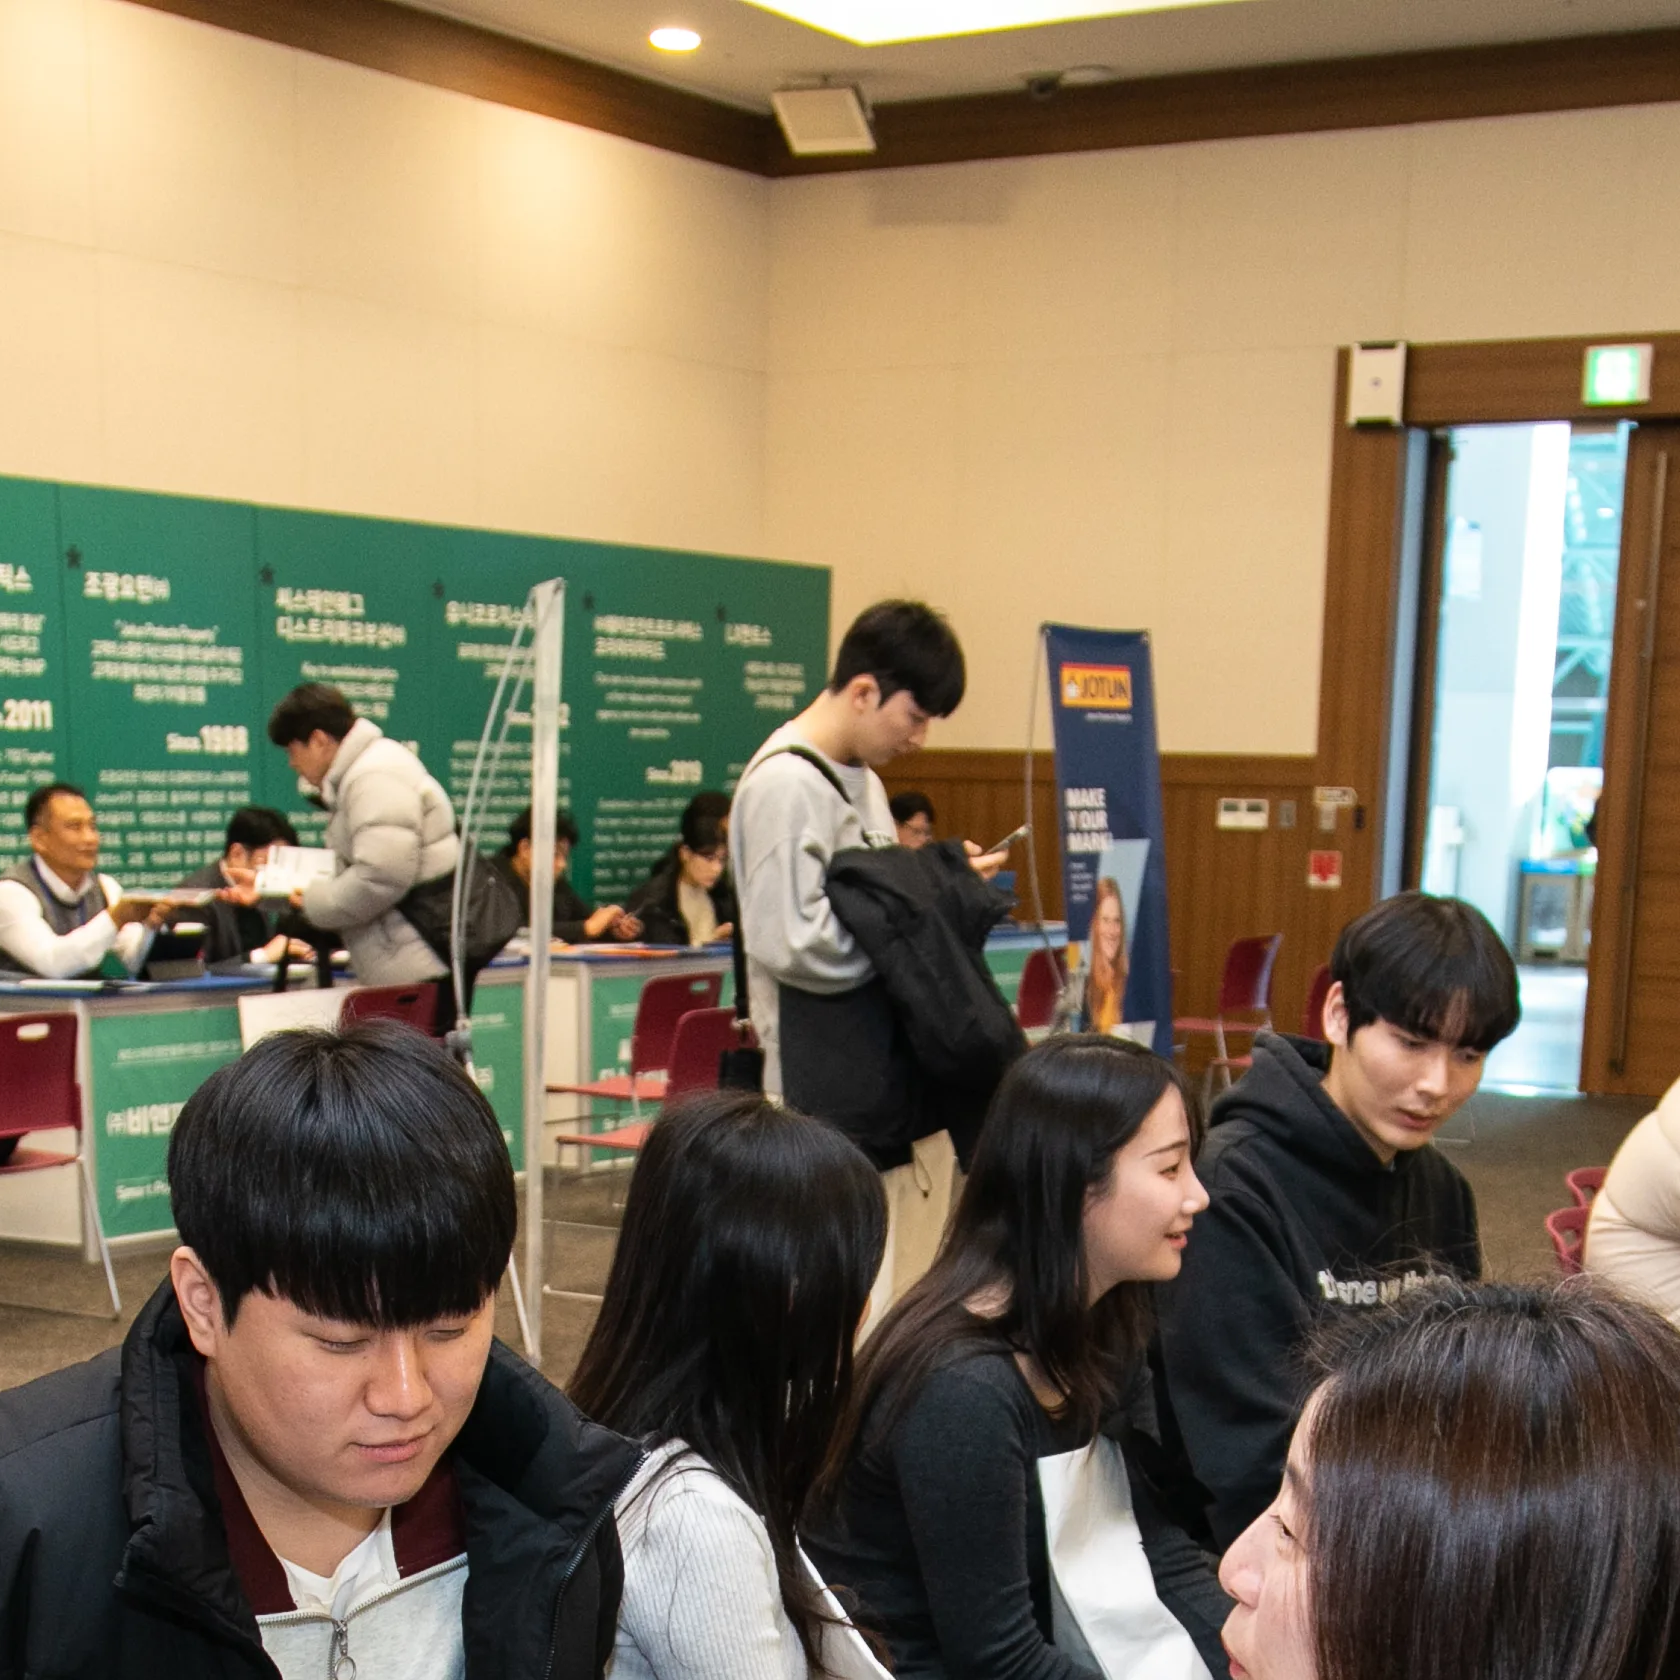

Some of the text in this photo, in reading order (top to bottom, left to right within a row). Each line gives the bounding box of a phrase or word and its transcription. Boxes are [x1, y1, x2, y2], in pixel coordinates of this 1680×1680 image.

[1080, 674, 1129, 700] JOTUN
[1065, 787, 1106, 808] MAKE
[1067, 809, 1108, 830] YOUR
